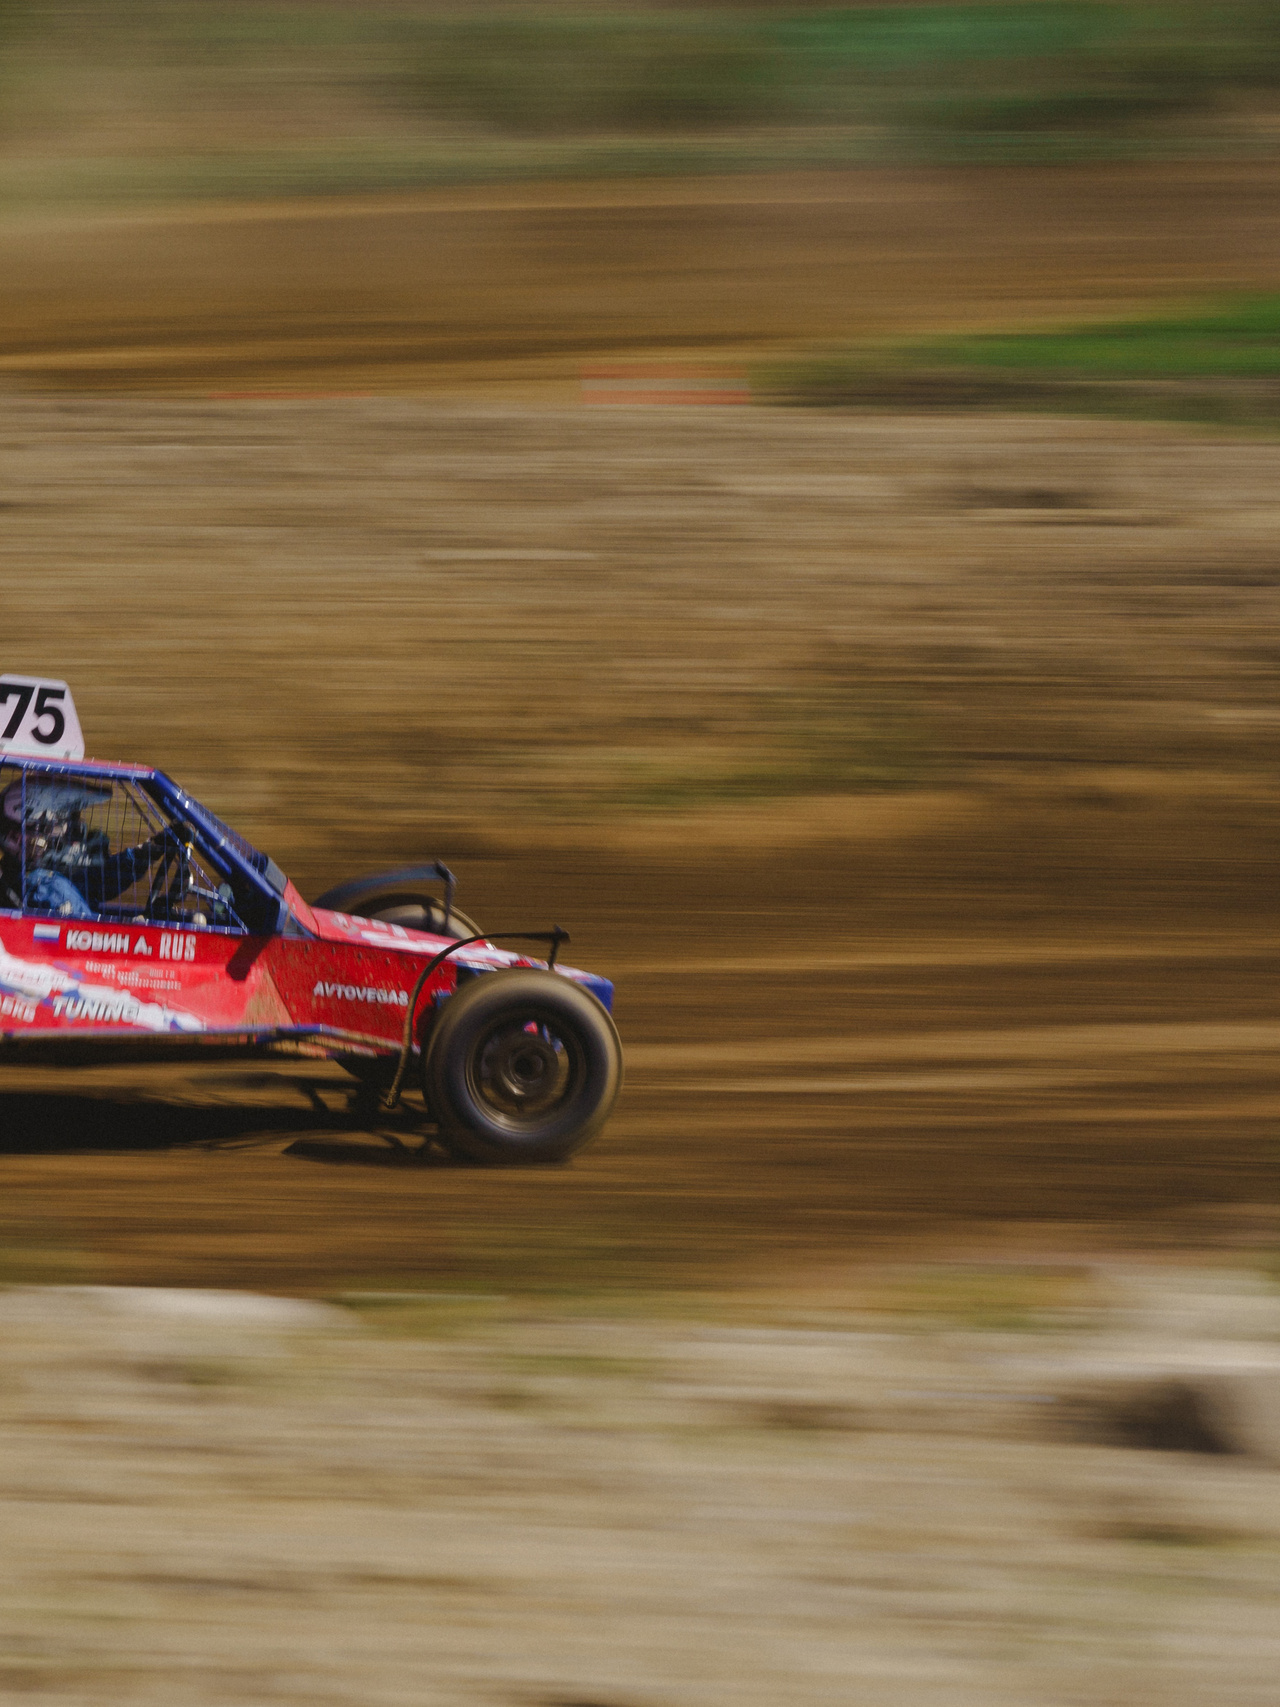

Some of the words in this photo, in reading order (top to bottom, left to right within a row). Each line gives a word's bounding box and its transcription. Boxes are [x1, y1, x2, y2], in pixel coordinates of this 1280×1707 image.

[159, 932, 197, 961] RUS
[313, 981, 410, 1007] AVTOVEGAS
[53, 996, 140, 1023] TUNING
